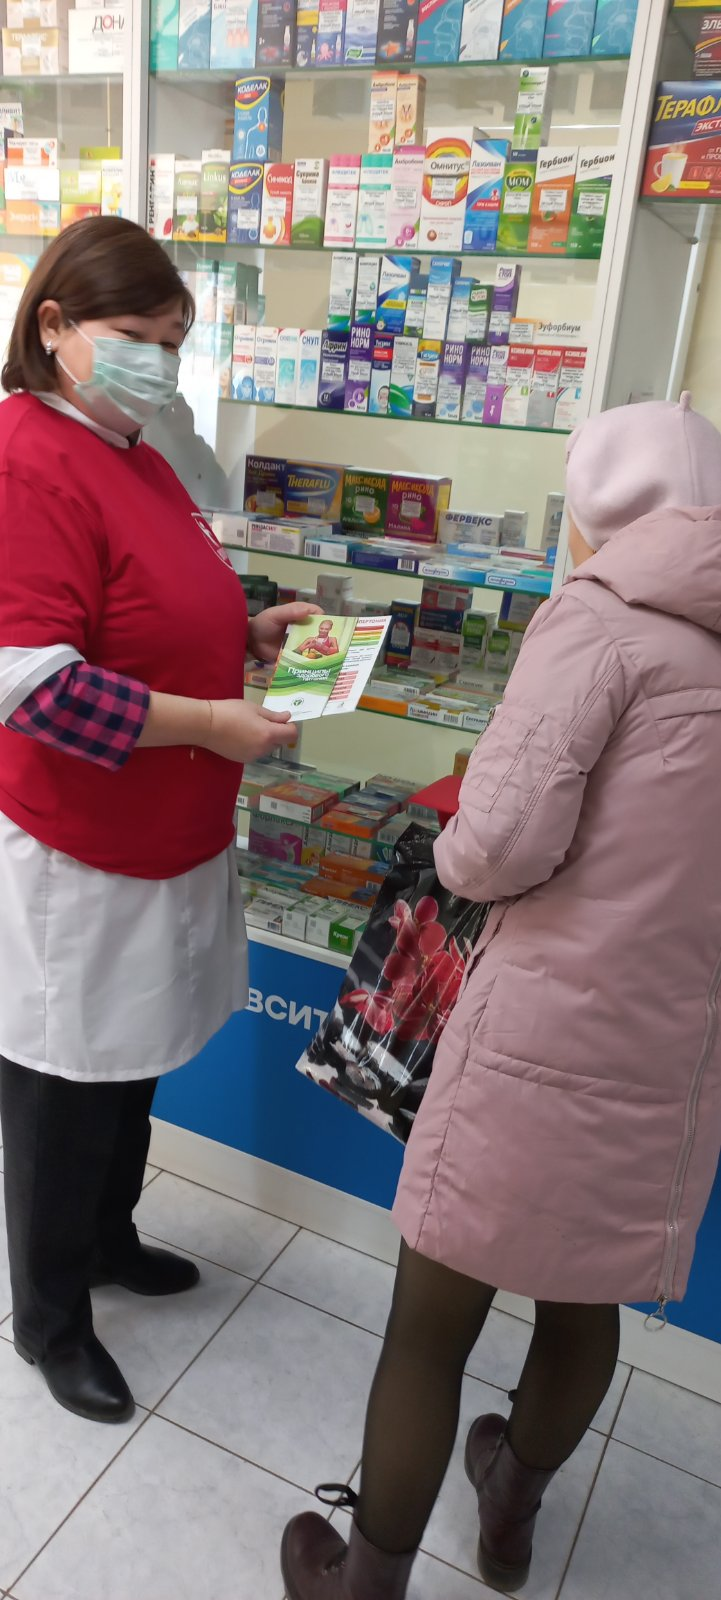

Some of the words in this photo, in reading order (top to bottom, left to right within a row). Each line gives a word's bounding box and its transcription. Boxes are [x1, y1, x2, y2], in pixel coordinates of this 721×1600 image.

[695, 119, 721, 132] ЭКСТ
[430, 161, 465, 172] Омнитус
[539, 153, 574, 168] Гербион
[580, 153, 616, 168] Гербион
[508, 177, 530, 187] МОМ
[351, 326, 371, 338] РИНО
[538, 322, 581, 333] Эуфорбиум
[302, 335, 319, 346] СНУП
[350, 337, 370, 349] НОРМ
[445, 343, 464, 355] РИНО
[471, 346, 491, 358] РИНО
[444, 353, 463, 366] НОРМ
[470, 356, 489, 367] НОРМ
[287, 474, 331, 489] THERAFLU
[445, 513, 493, 527] ФЕРВЕКС
[287, 667, 332, 675] Принципы
